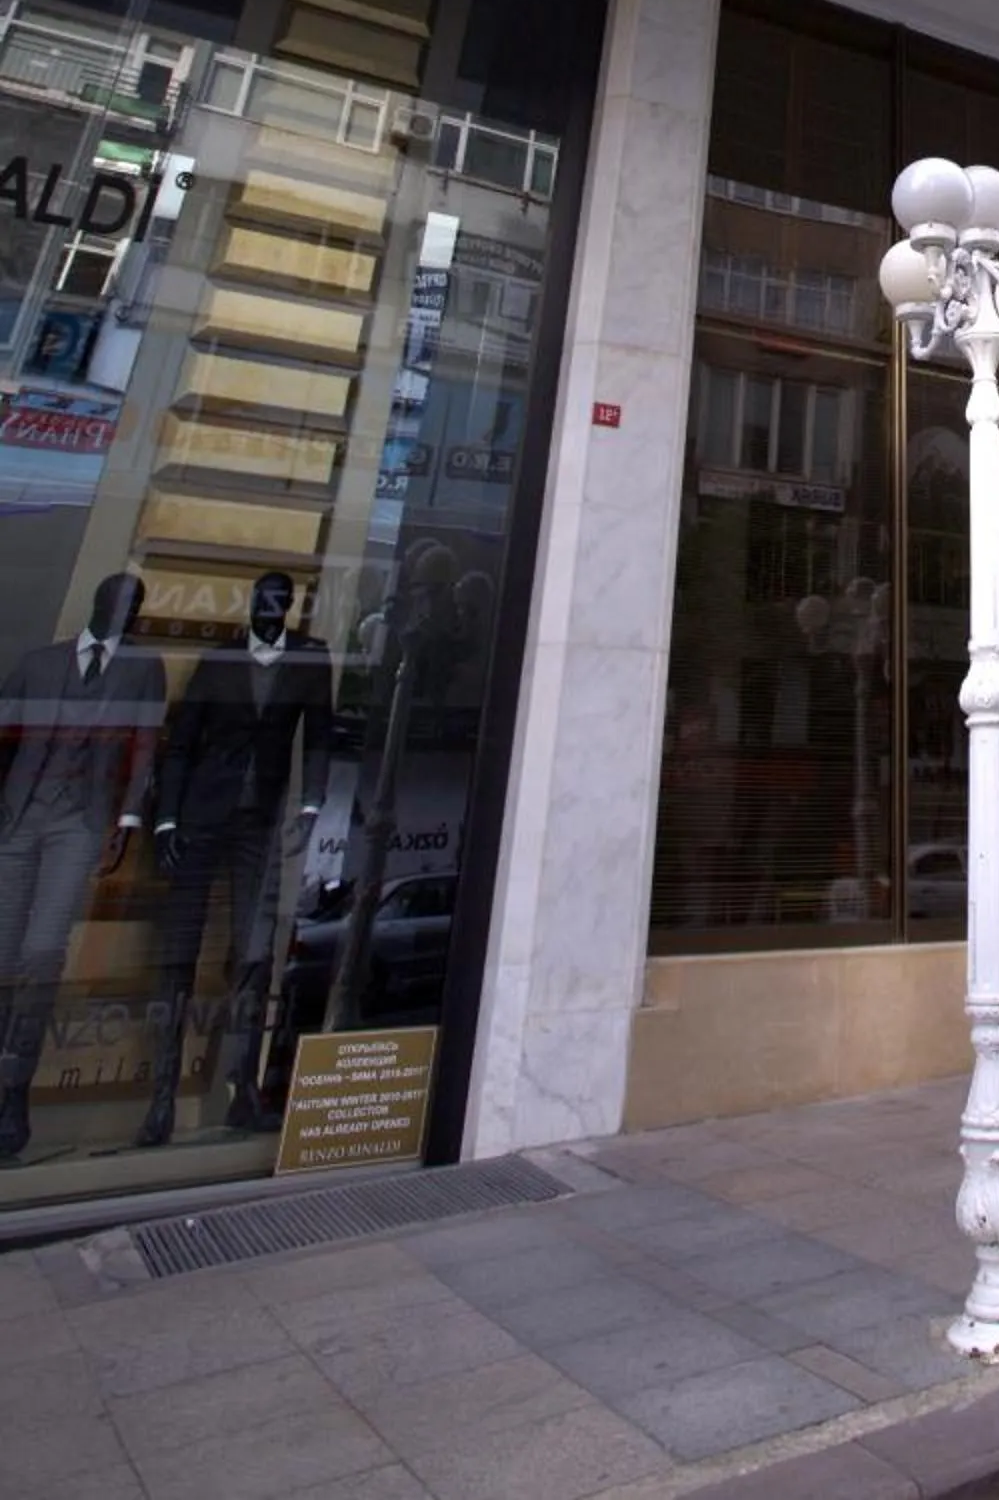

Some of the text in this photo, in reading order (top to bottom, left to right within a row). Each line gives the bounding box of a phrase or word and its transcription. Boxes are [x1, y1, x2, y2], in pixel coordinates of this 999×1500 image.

[58, 1056, 207, 1089] milao
[328, 1105, 389, 1121] COLLECTION
[323, 1122, 369, 1137] ALREADY
[371, 1117, 411, 1132] OPENED
